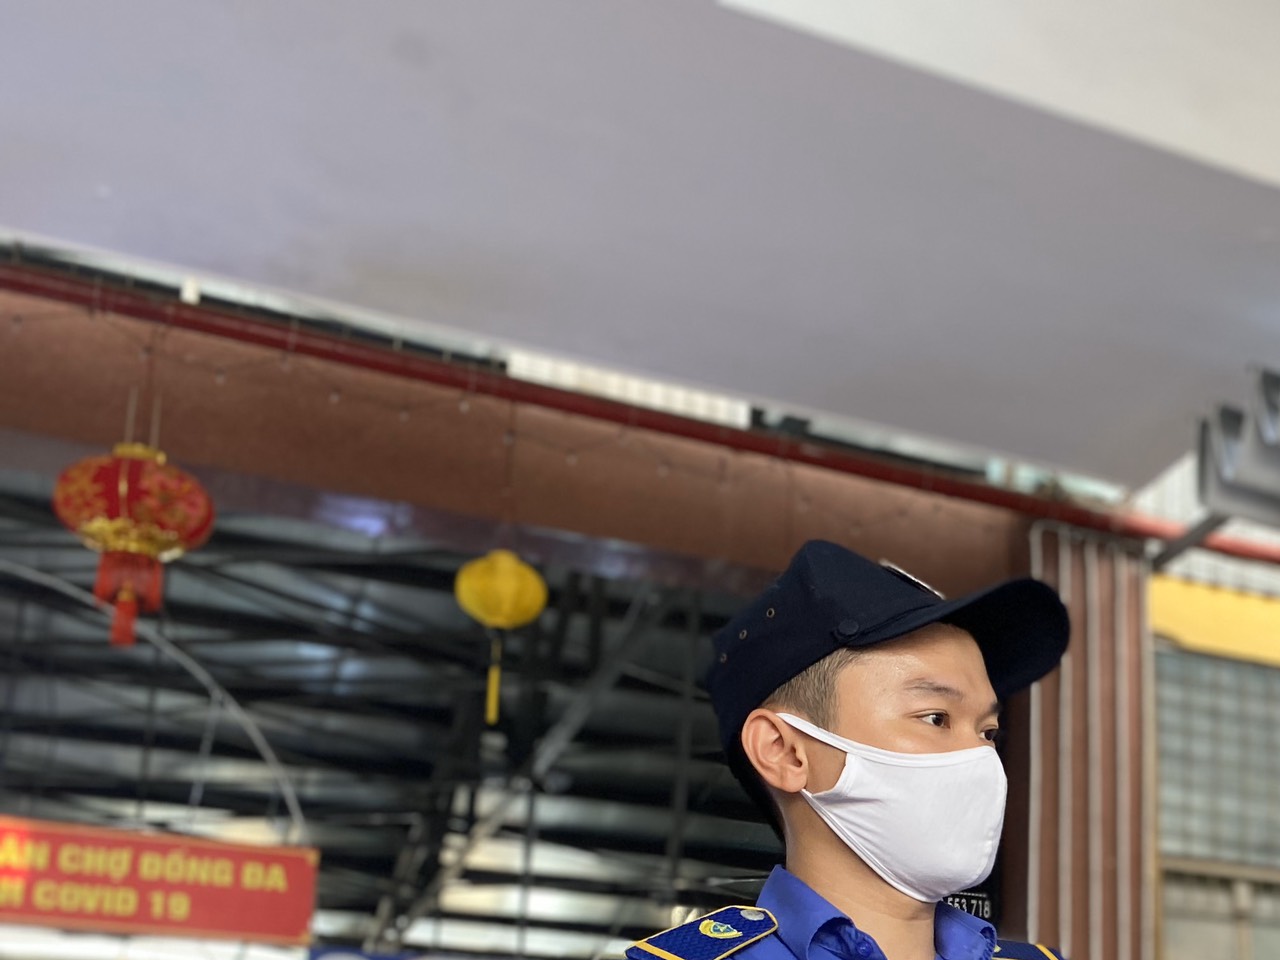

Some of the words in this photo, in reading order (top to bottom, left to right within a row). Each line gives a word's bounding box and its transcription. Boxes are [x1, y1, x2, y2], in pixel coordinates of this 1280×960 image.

[32, 879, 139, 917] COVID
[149, 890, 191, 922] 19
[970, 899, 992, 919] 718
